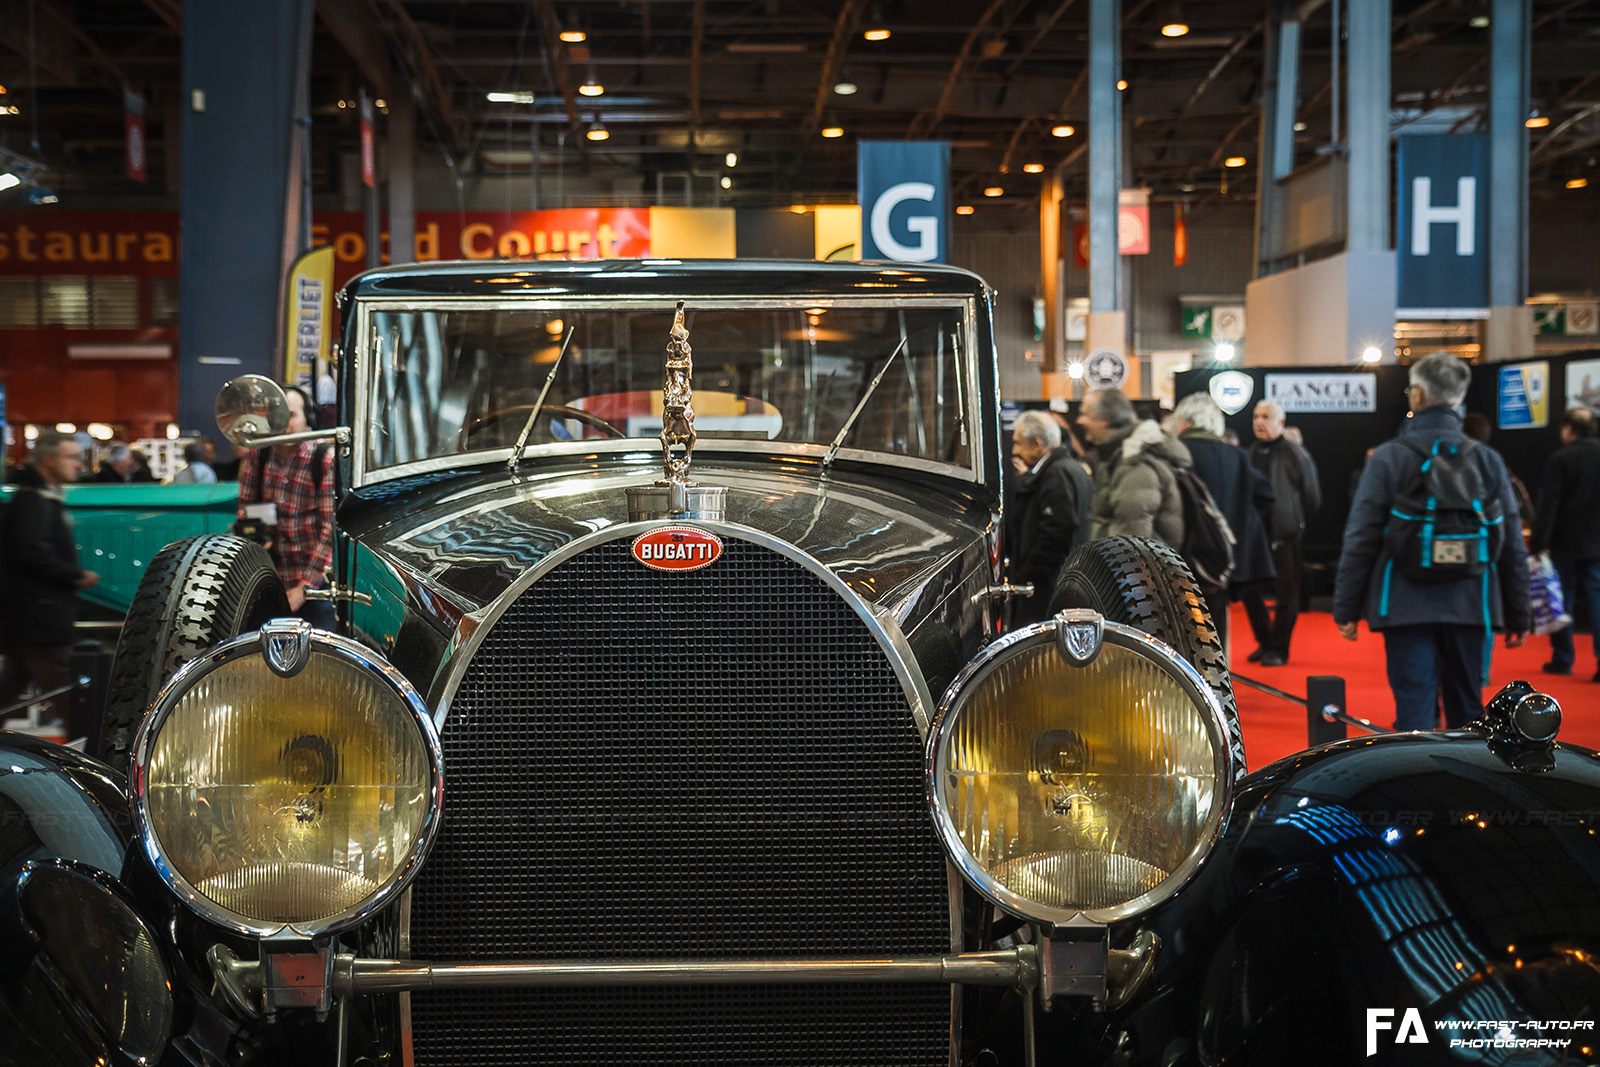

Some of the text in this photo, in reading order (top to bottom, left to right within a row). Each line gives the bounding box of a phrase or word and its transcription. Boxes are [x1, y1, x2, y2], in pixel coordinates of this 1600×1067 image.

[461, 223, 619, 259] Court
[870, 182, 938, 262] G
[1412, 176, 1476, 256] H
[297, 275, 323, 365] BERLIET
[1271, 381, 1370, 398] LANCIA
[641, 543, 713, 560] BUGATTI
